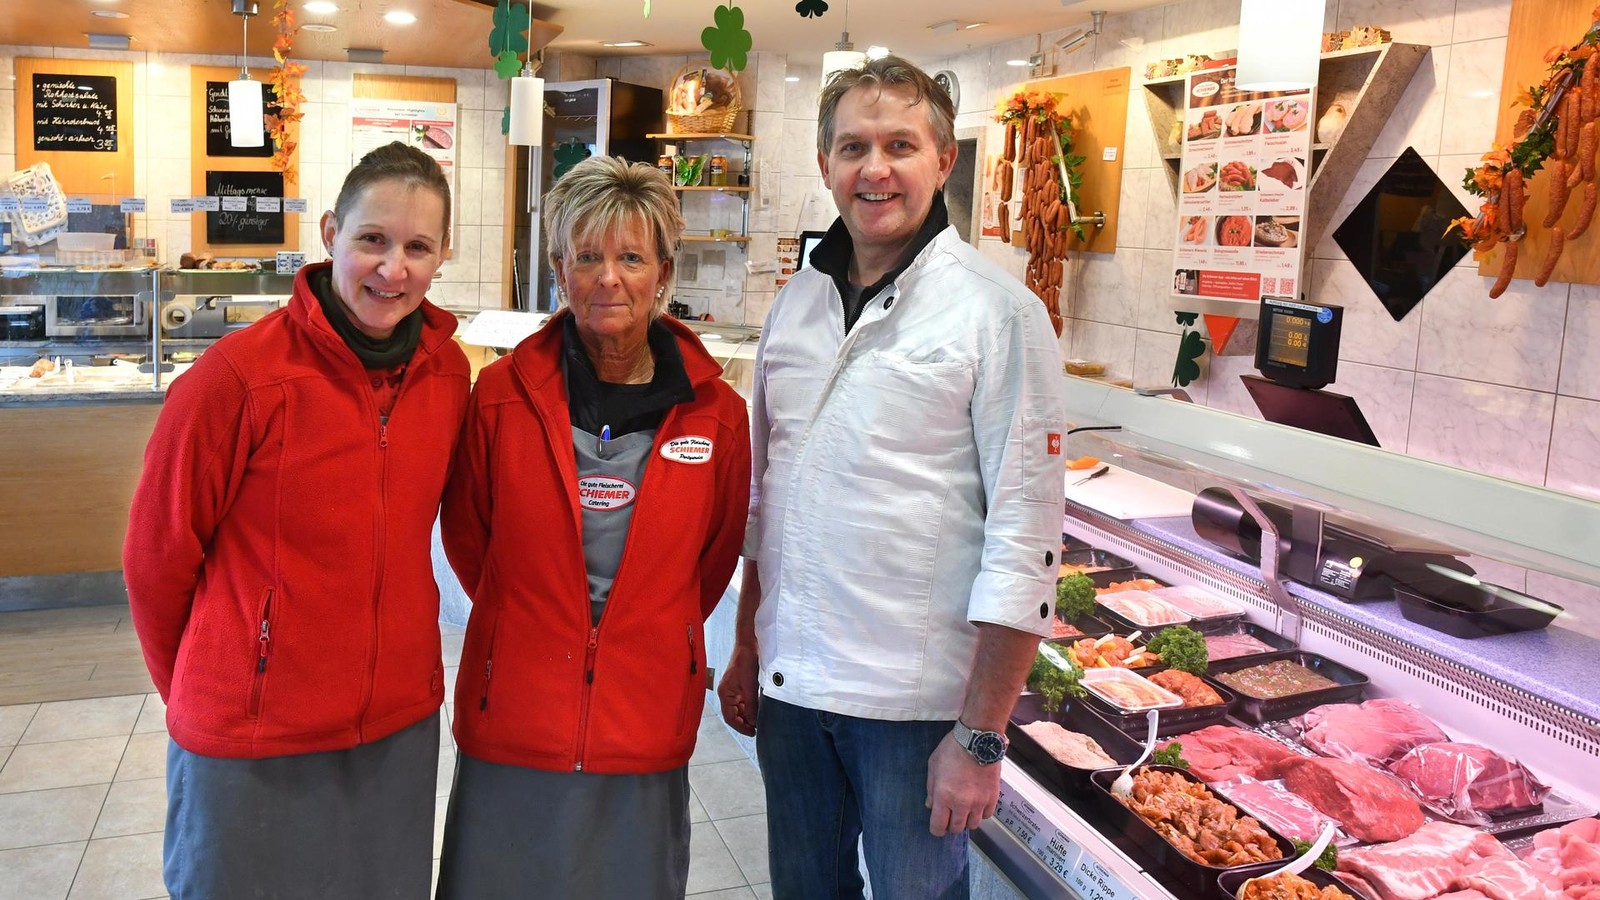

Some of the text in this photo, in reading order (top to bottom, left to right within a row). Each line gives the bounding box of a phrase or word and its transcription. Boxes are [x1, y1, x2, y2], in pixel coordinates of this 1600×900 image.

[579, 489, 630, 499] CHIEMER
[1050, 837, 1067, 856] Hüfte
[1050, 858, 1063, 873] 3,29
[1063, 870, 1068, 879] €
[1080, 863, 1115, 897] Dicke Rippe
